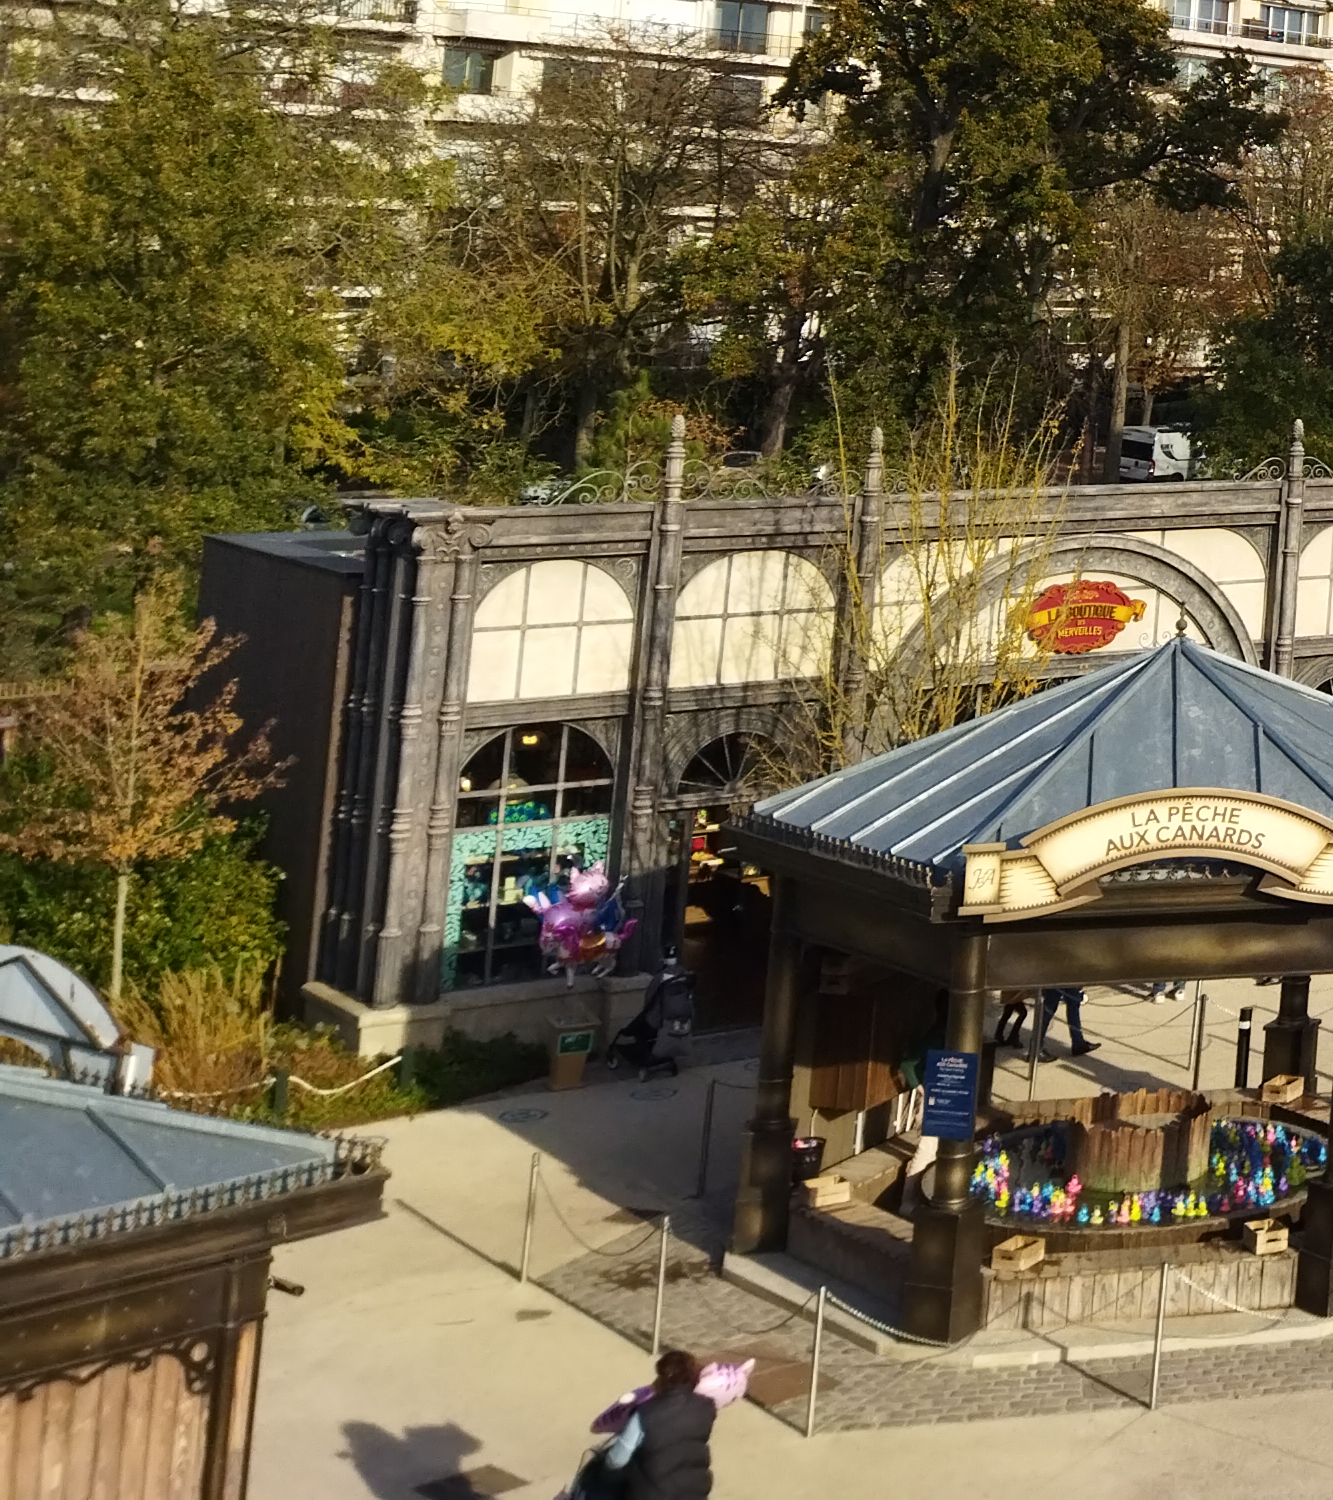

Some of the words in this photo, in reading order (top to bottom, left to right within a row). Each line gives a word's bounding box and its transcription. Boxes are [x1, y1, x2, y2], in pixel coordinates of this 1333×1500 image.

[1057, 625, 1103, 638] MERVEILLES
[1131, 808, 1160, 828] LA
[1168, 801, 1242, 825] PÊCHE
[1105, 828, 1150, 857] AUX
[1156, 824, 1266, 850] CANARDS
